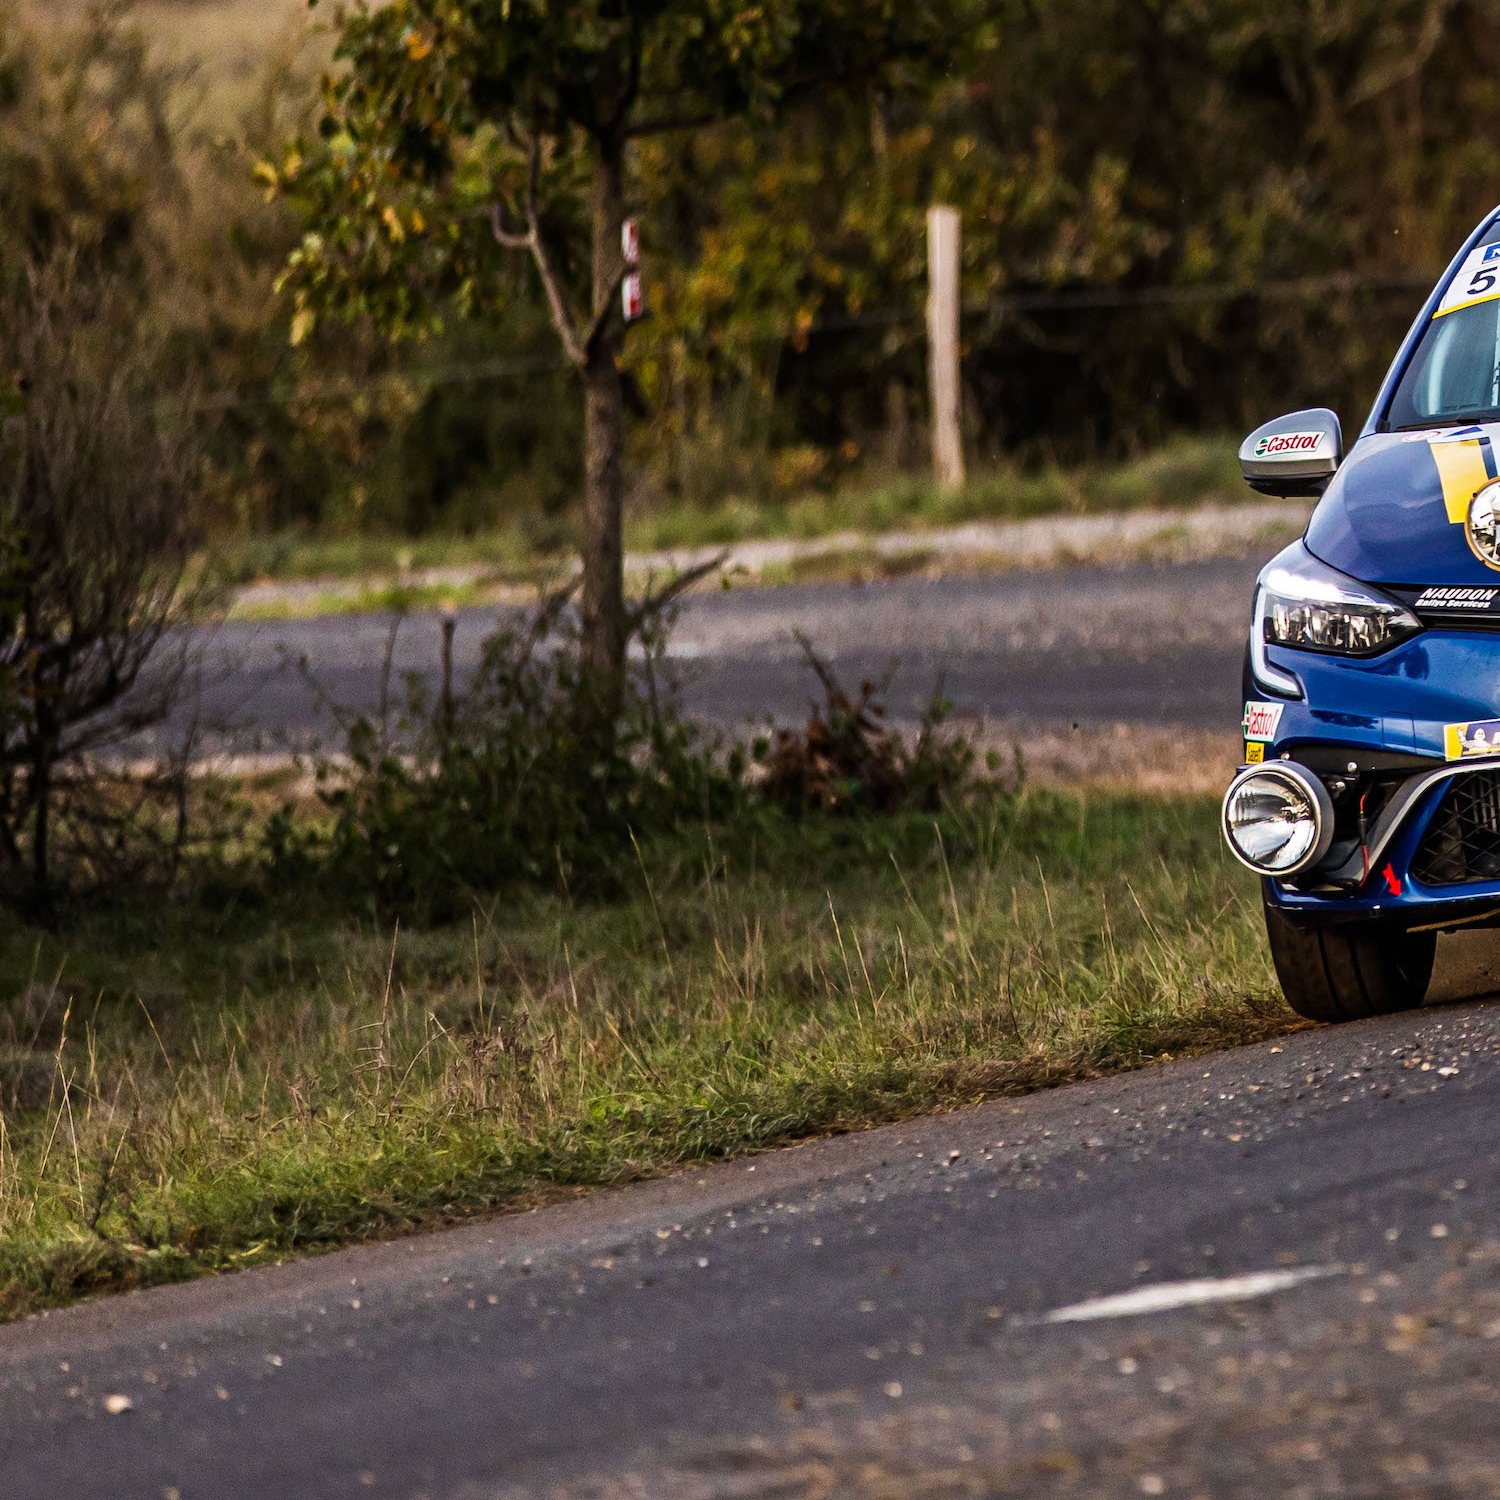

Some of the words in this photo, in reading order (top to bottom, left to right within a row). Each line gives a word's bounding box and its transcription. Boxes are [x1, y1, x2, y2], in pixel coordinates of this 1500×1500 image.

[1266, 433, 1321, 452] Castrol
[1420, 588, 1499, 601] NAUDON
[1446, 600, 1491, 608] Services
